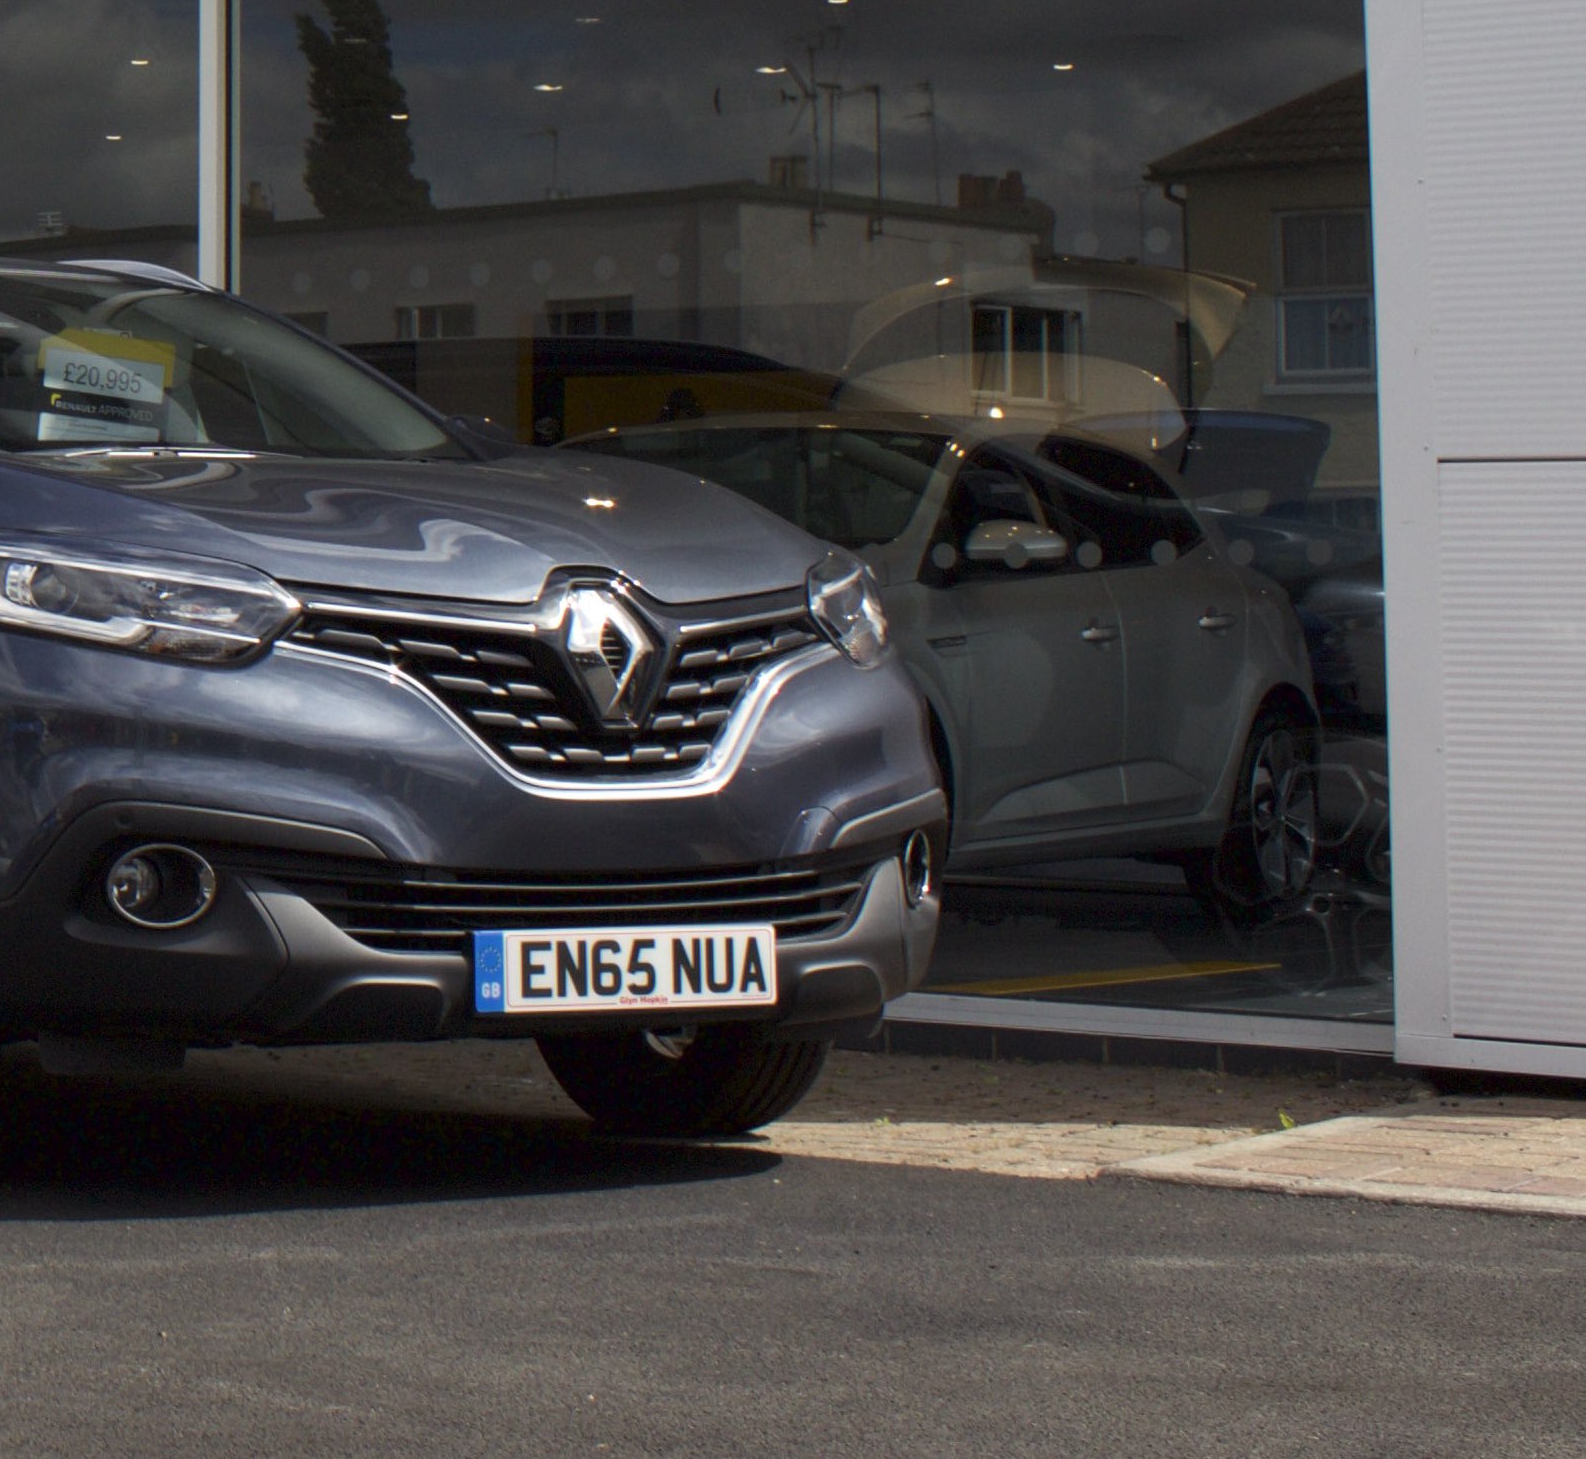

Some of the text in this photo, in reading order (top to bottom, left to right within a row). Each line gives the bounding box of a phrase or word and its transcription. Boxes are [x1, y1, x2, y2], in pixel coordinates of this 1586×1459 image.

[63, 362, 143, 393] £20,995
[56, 400, 154, 421] RENAULT APPROVED
[520, 936, 767, 998] EN65 NUA
[481, 982, 501, 999] GB
